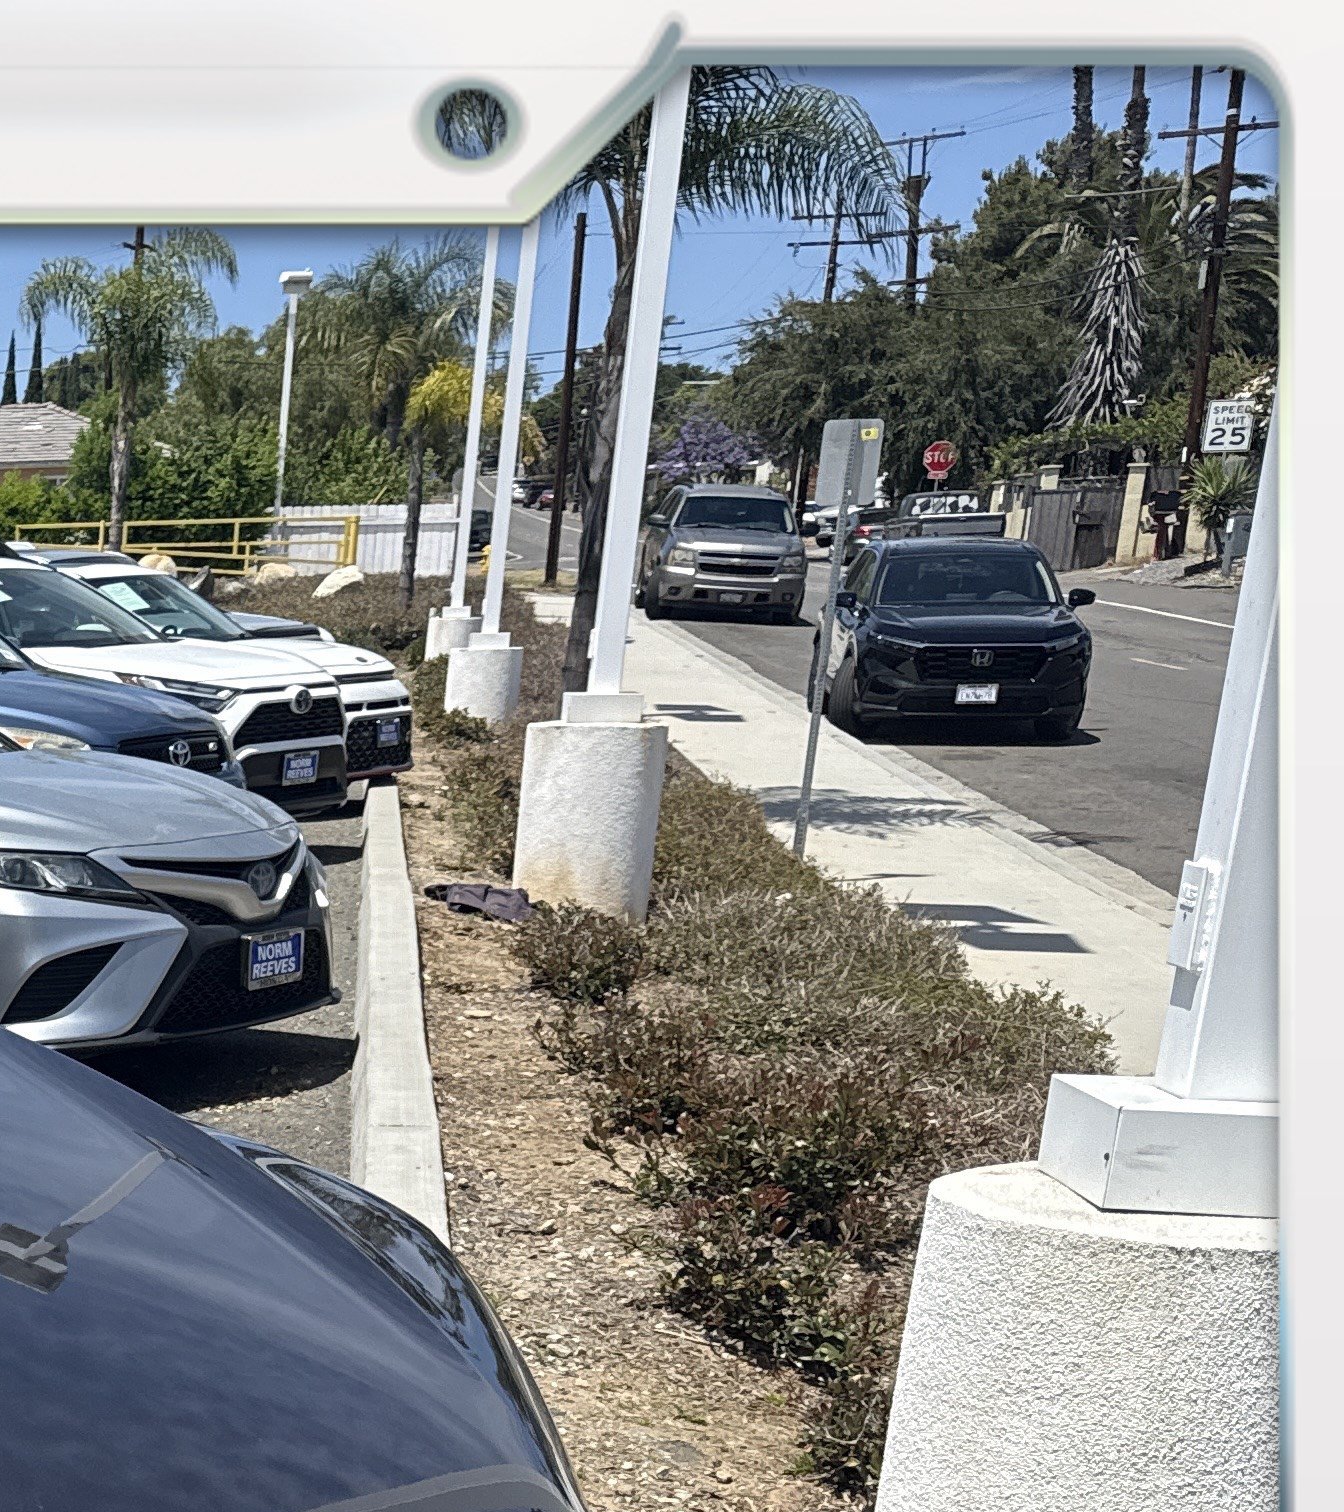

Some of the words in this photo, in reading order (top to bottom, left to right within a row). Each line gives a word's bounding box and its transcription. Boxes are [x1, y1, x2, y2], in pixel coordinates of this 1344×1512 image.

[1213, 404, 1253, 414] SPEED
[1215, 415, 1246, 426] LIMIT
[1208, 427, 1246, 446] 25
[257, 940, 293, 962] NORM
[252, 956, 296, 980] REEVES
